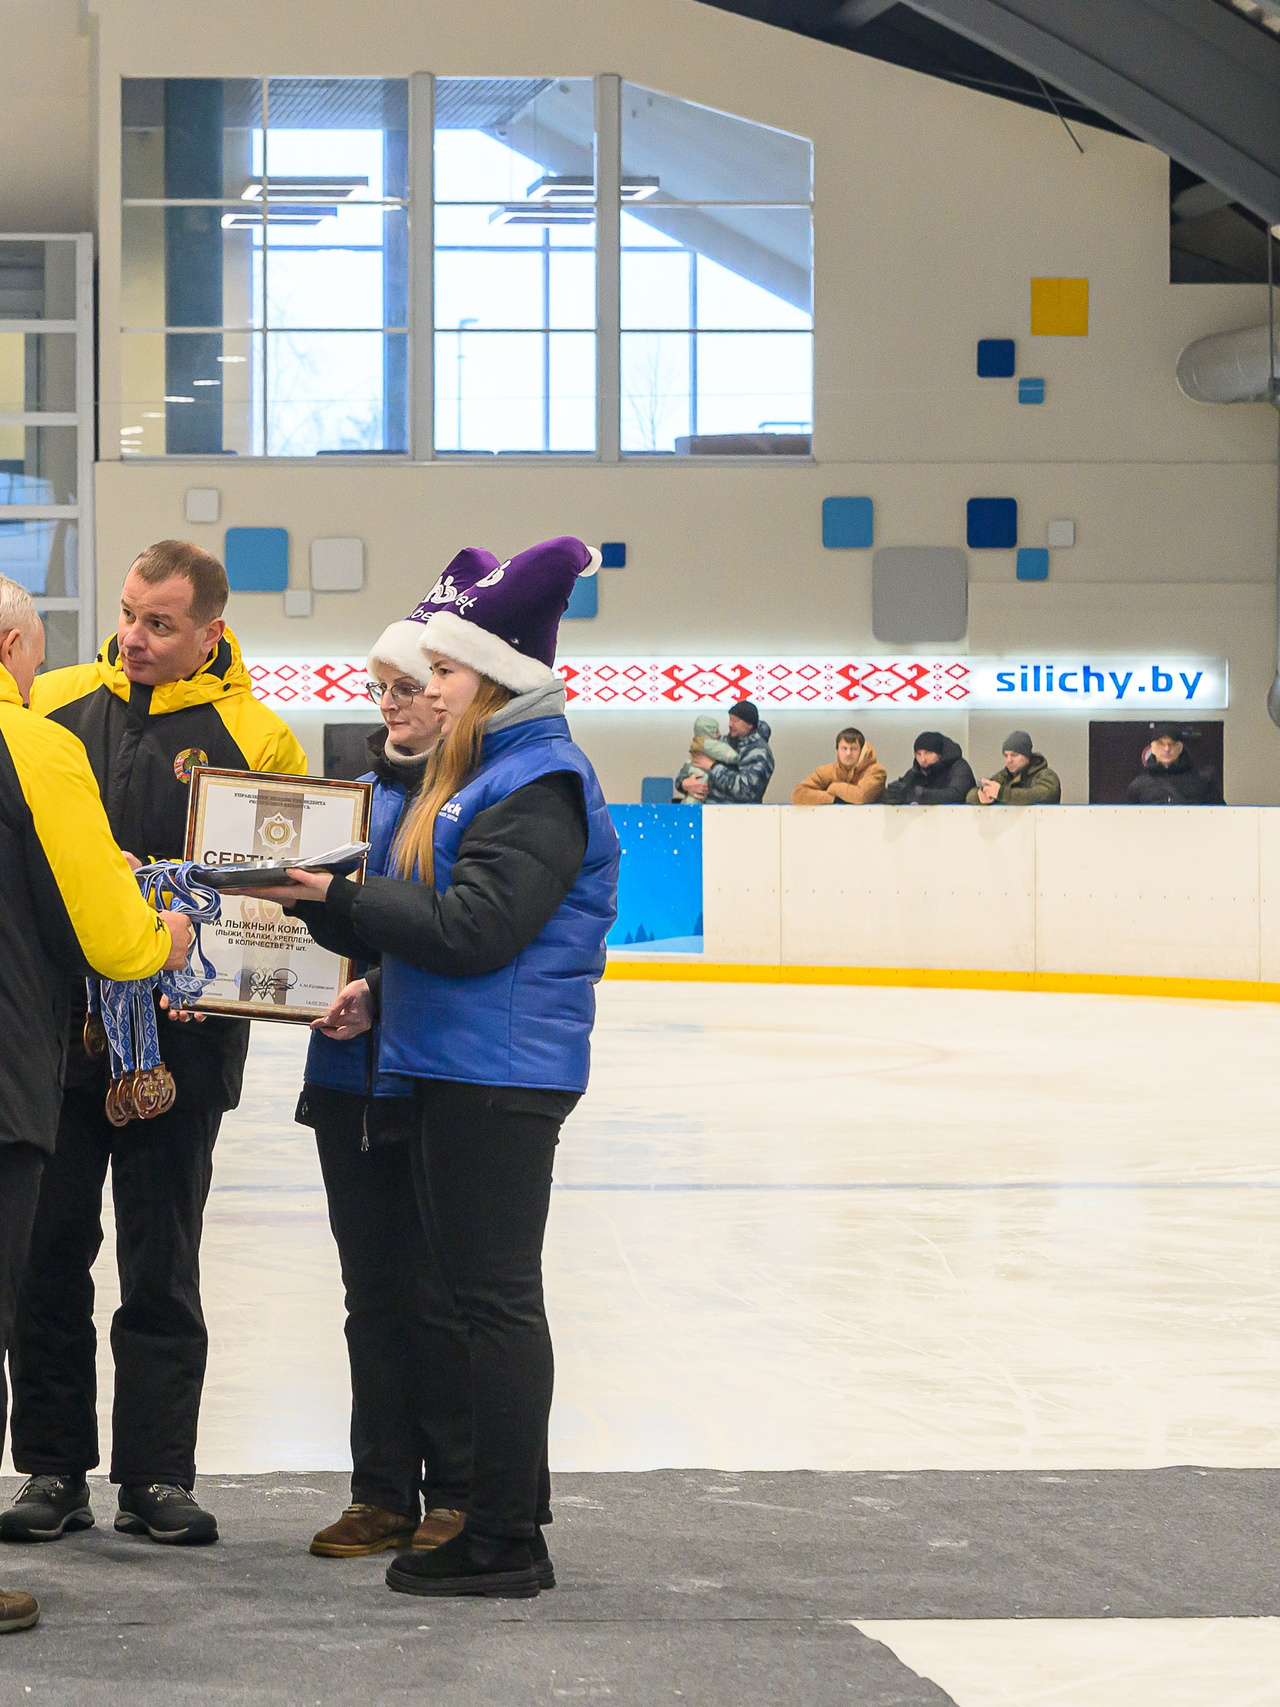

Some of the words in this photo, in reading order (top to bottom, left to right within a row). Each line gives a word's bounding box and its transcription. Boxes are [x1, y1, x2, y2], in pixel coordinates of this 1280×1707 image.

[995, 665, 1204, 700] silichy.by
[225, 919, 276, 932] ЛЫЖНЫЙ
[234, 938, 284, 949] КОЛИЧЕСТВЕ
